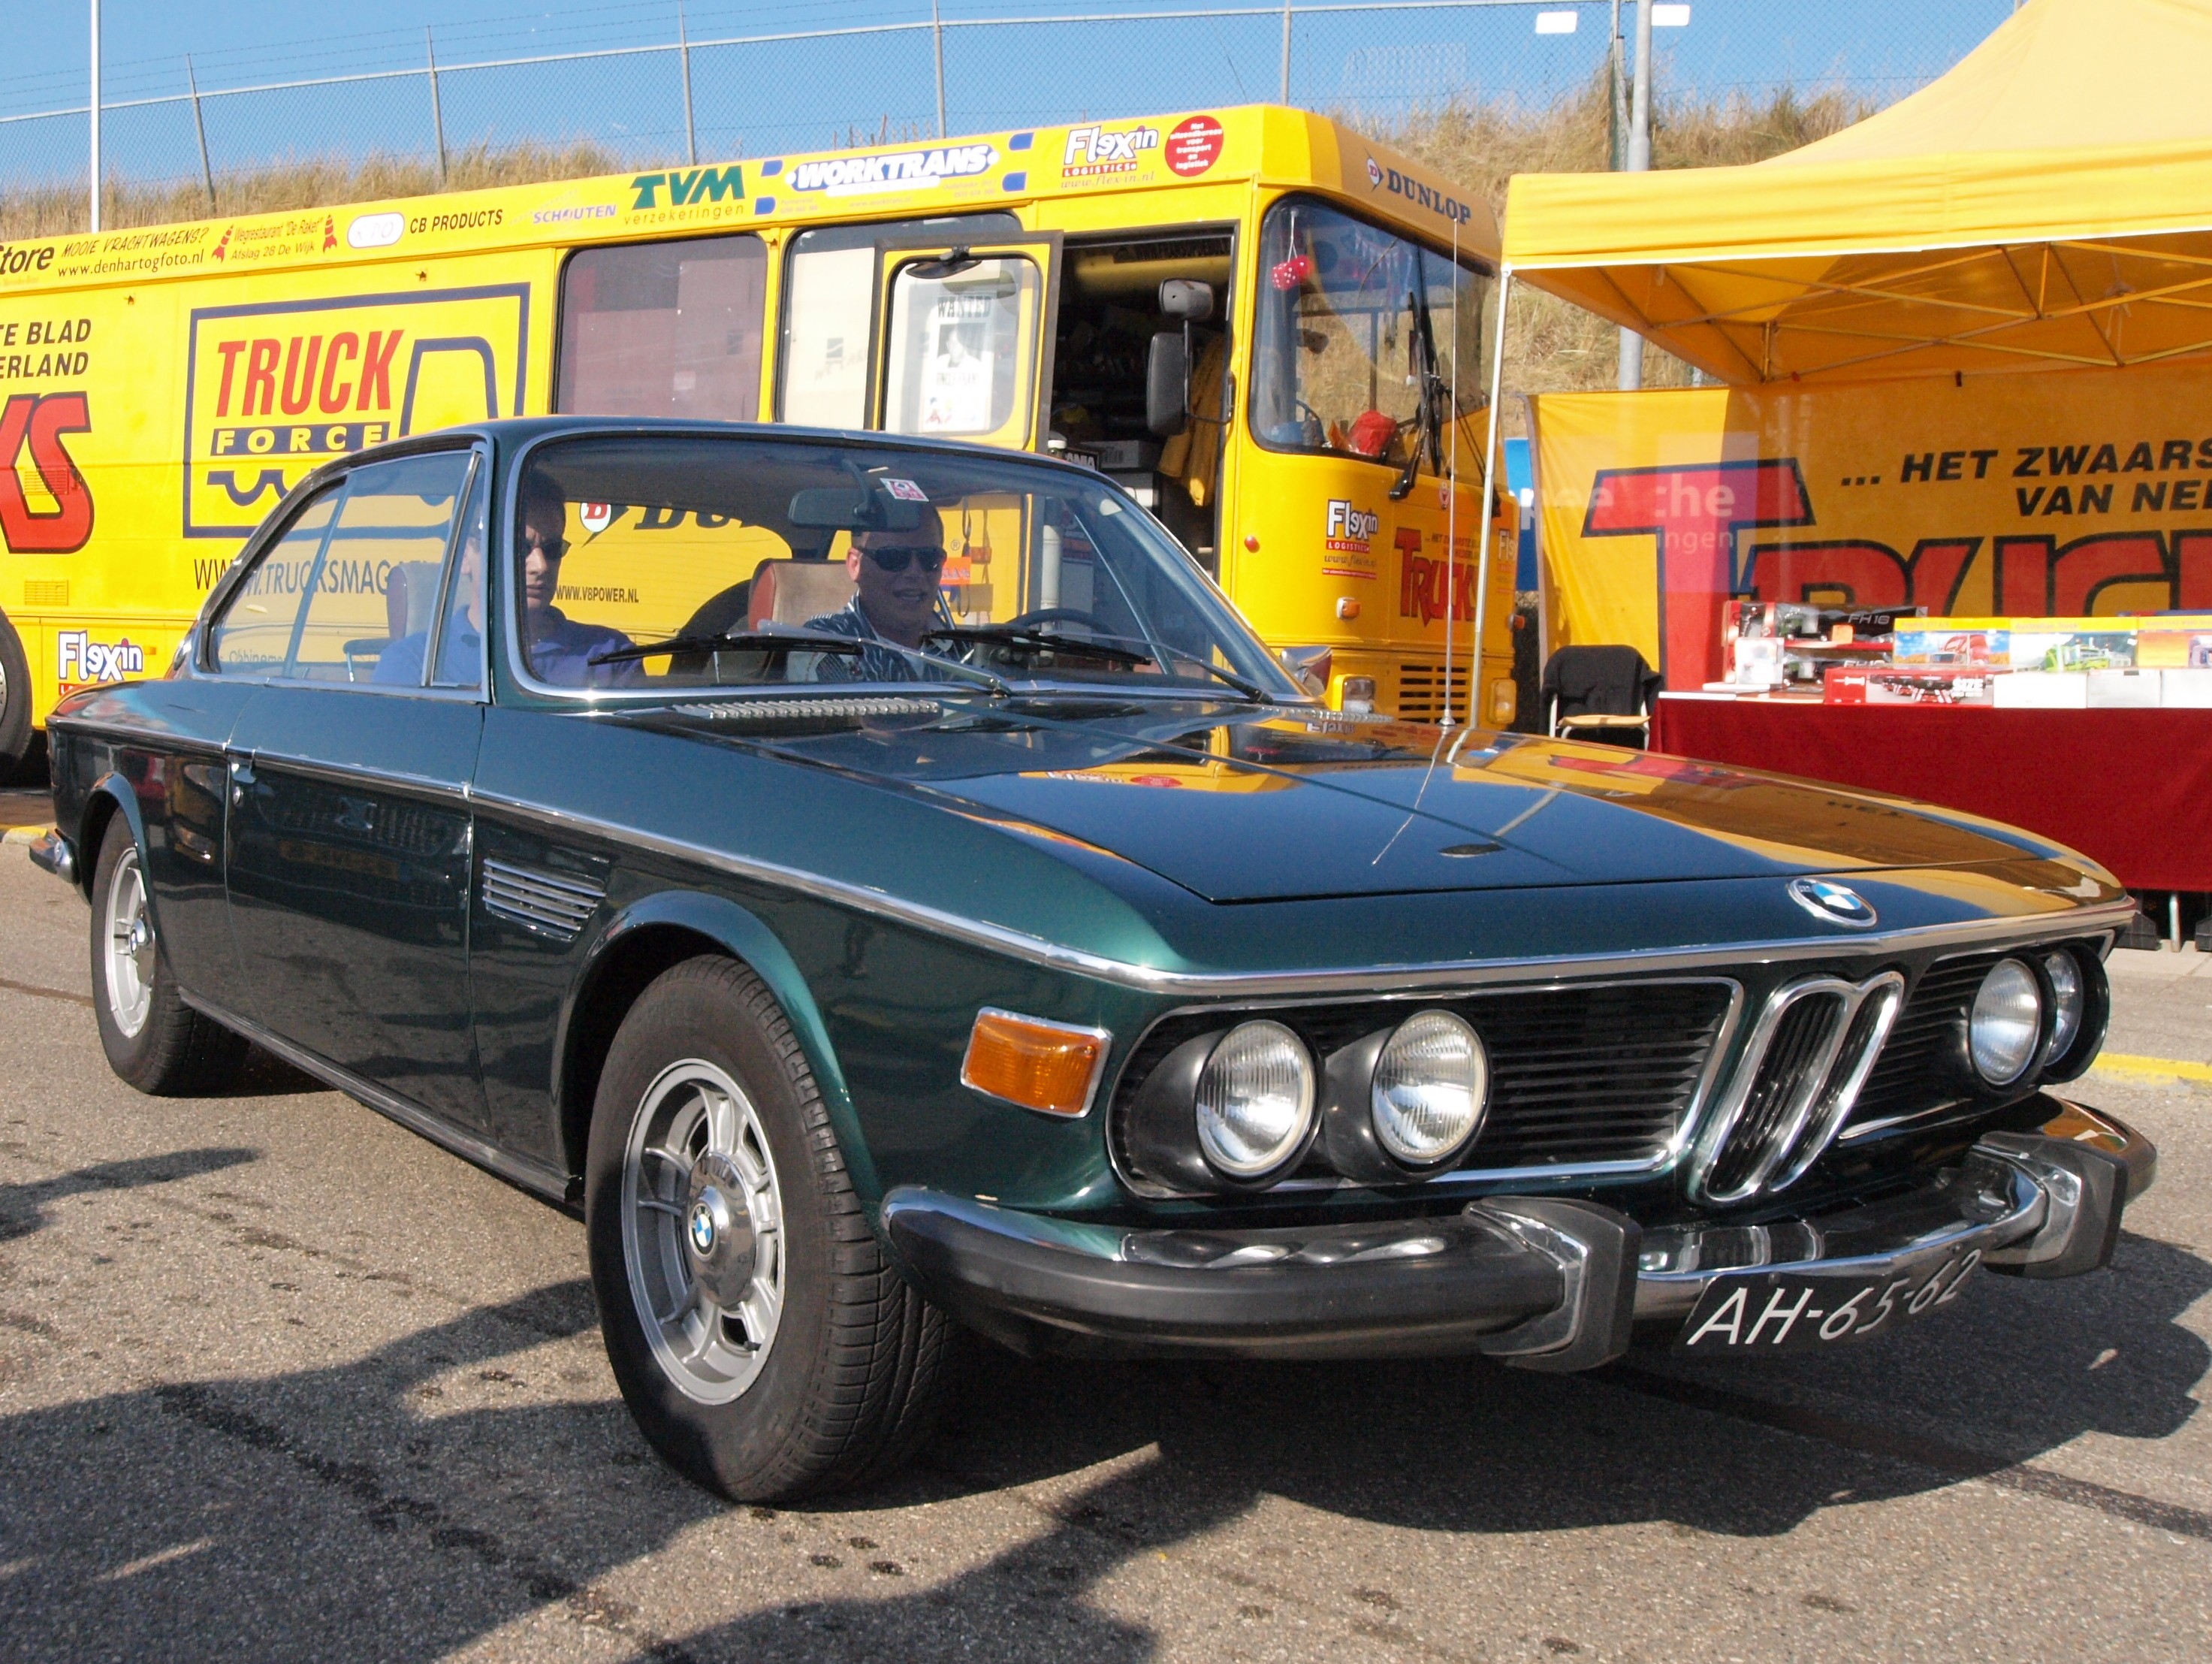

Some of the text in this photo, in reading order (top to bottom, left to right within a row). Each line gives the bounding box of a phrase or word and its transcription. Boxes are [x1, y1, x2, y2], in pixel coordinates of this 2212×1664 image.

[798, 145, 988, 189] WORKTRANS
[630, 165, 745, 210] TVM
[1387, 168, 1471, 225] DUNLOP
[410, 217, 427, 234] CB
[432, 209, 503, 232] PRODUCTS
[624, 204, 744, 225] verzekeringen
[58, 249, 204, 277] www.denhartogfoto.nl
[62, 240, 99, 258] MOOIE
[26, 319, 92, 345] BLAD
[216, 329, 404, 417] TRUCK
[216, 424, 382, 455] FORCE
[1900, 448, 1998, 483] HET
[2016, 479, 2212, 517] VAN NE
[556, 585, 638, 603] WWW.V8POWER.NL
[1687, 1248, 1982, 1345] AH-65-62
